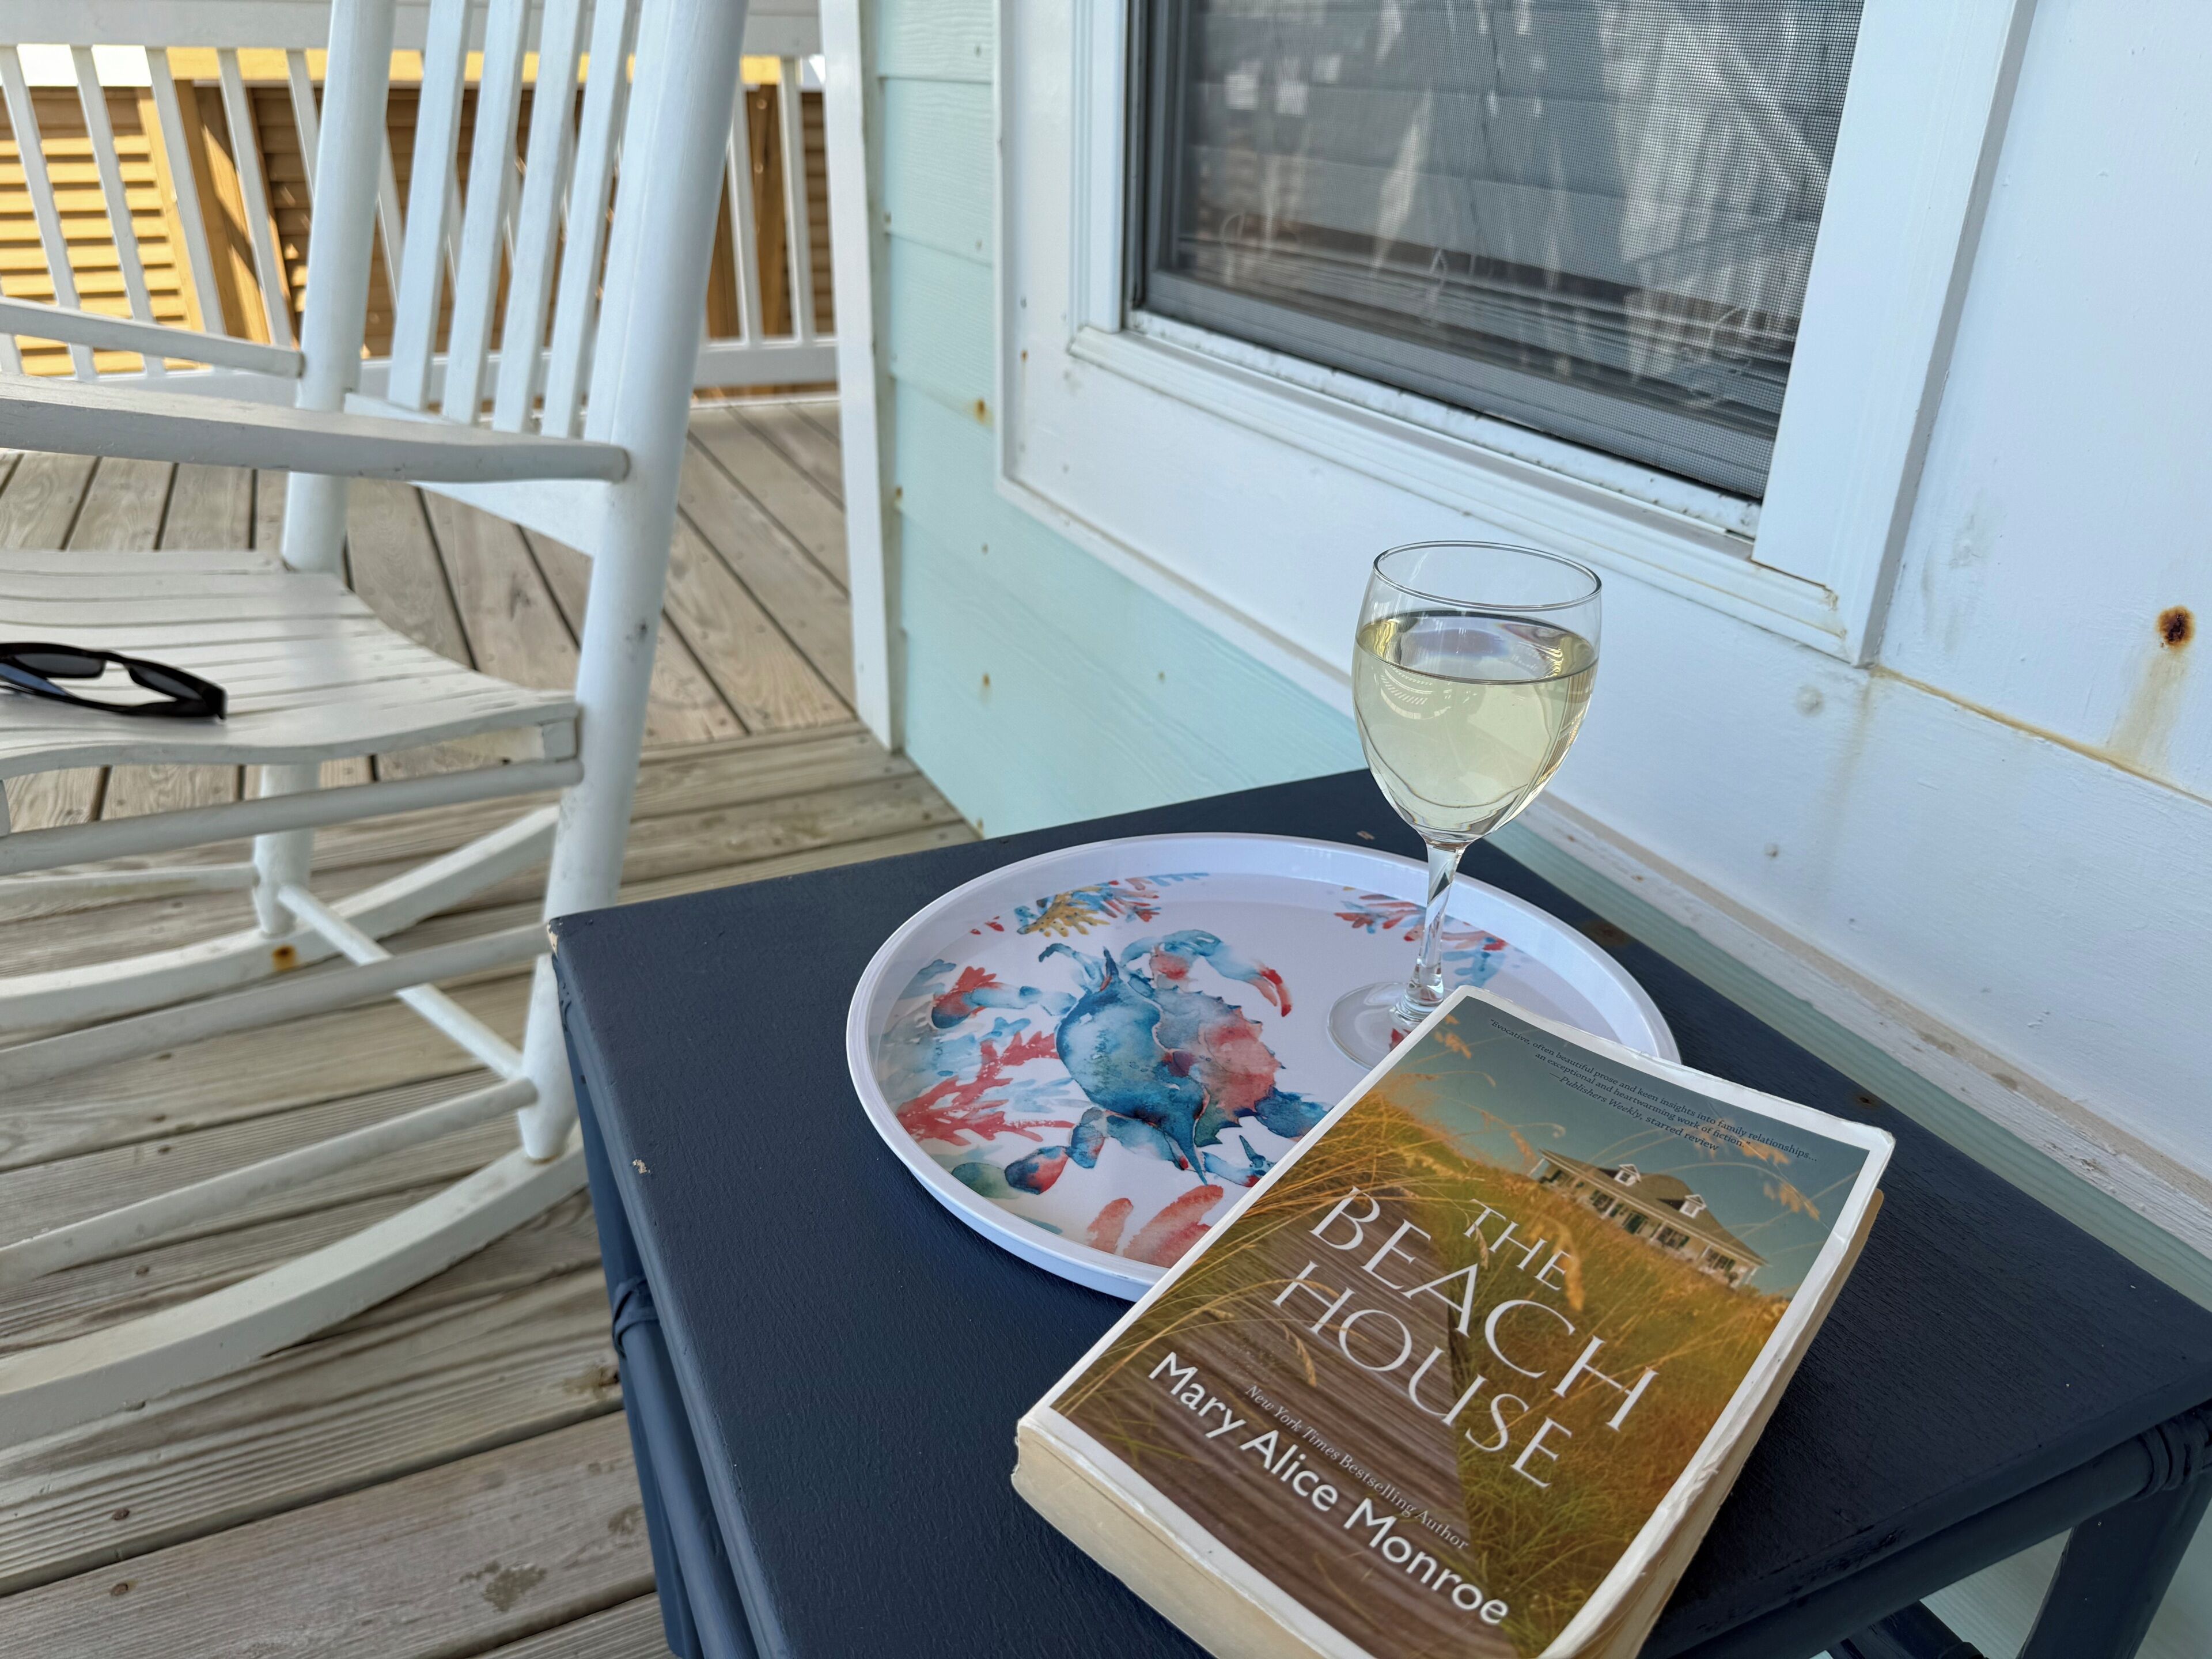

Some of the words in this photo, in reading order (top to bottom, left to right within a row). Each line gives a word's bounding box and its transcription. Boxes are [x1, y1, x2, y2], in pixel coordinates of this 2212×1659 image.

[1533, 1043, 1554, 1055] often
[1555, 1052, 1594, 1074] beautiful
[1593, 1071, 1618, 1085] prose
[1619, 1082, 1637, 1093] and
[1638, 1088, 1658, 1101] keen
[1660, 1098, 1696, 1117] insights
[1698, 1112, 1716, 1124] into
[1718, 1120, 1747, 1137] family
[1547, 1059, 1595, 1084] exceptional
[1596, 1081, 1613, 1093] and
[1613, 1088, 1676, 1121] heartwarming
[1677, 1116, 1700, 1130] work
[1701, 1126, 1713, 1134] of
[1609, 1098, 1643, 1120] Weekly,
[1646, 1116, 1684, 1135] starred
[1684, 1132, 1719, 1150] review
[1309, 1185, 1659, 1431] BEACH
[1463, 1199, 1573, 1291] THE
[1272, 1261, 1571, 1488] HOUSE
[1149, 1351, 1247, 1438] Mary
[1240, 1430, 1338, 1512] Alice
[1343, 1497, 1509, 1626] Monroe
[1245, 1385, 1275, 1410] New
[1274, 1406, 1302, 1432] York
[1302, 1426, 1341, 1460] Times
[1339, 1452, 1416, 1518] Bestselling
[1415, 1510, 1468, 1549] Author
